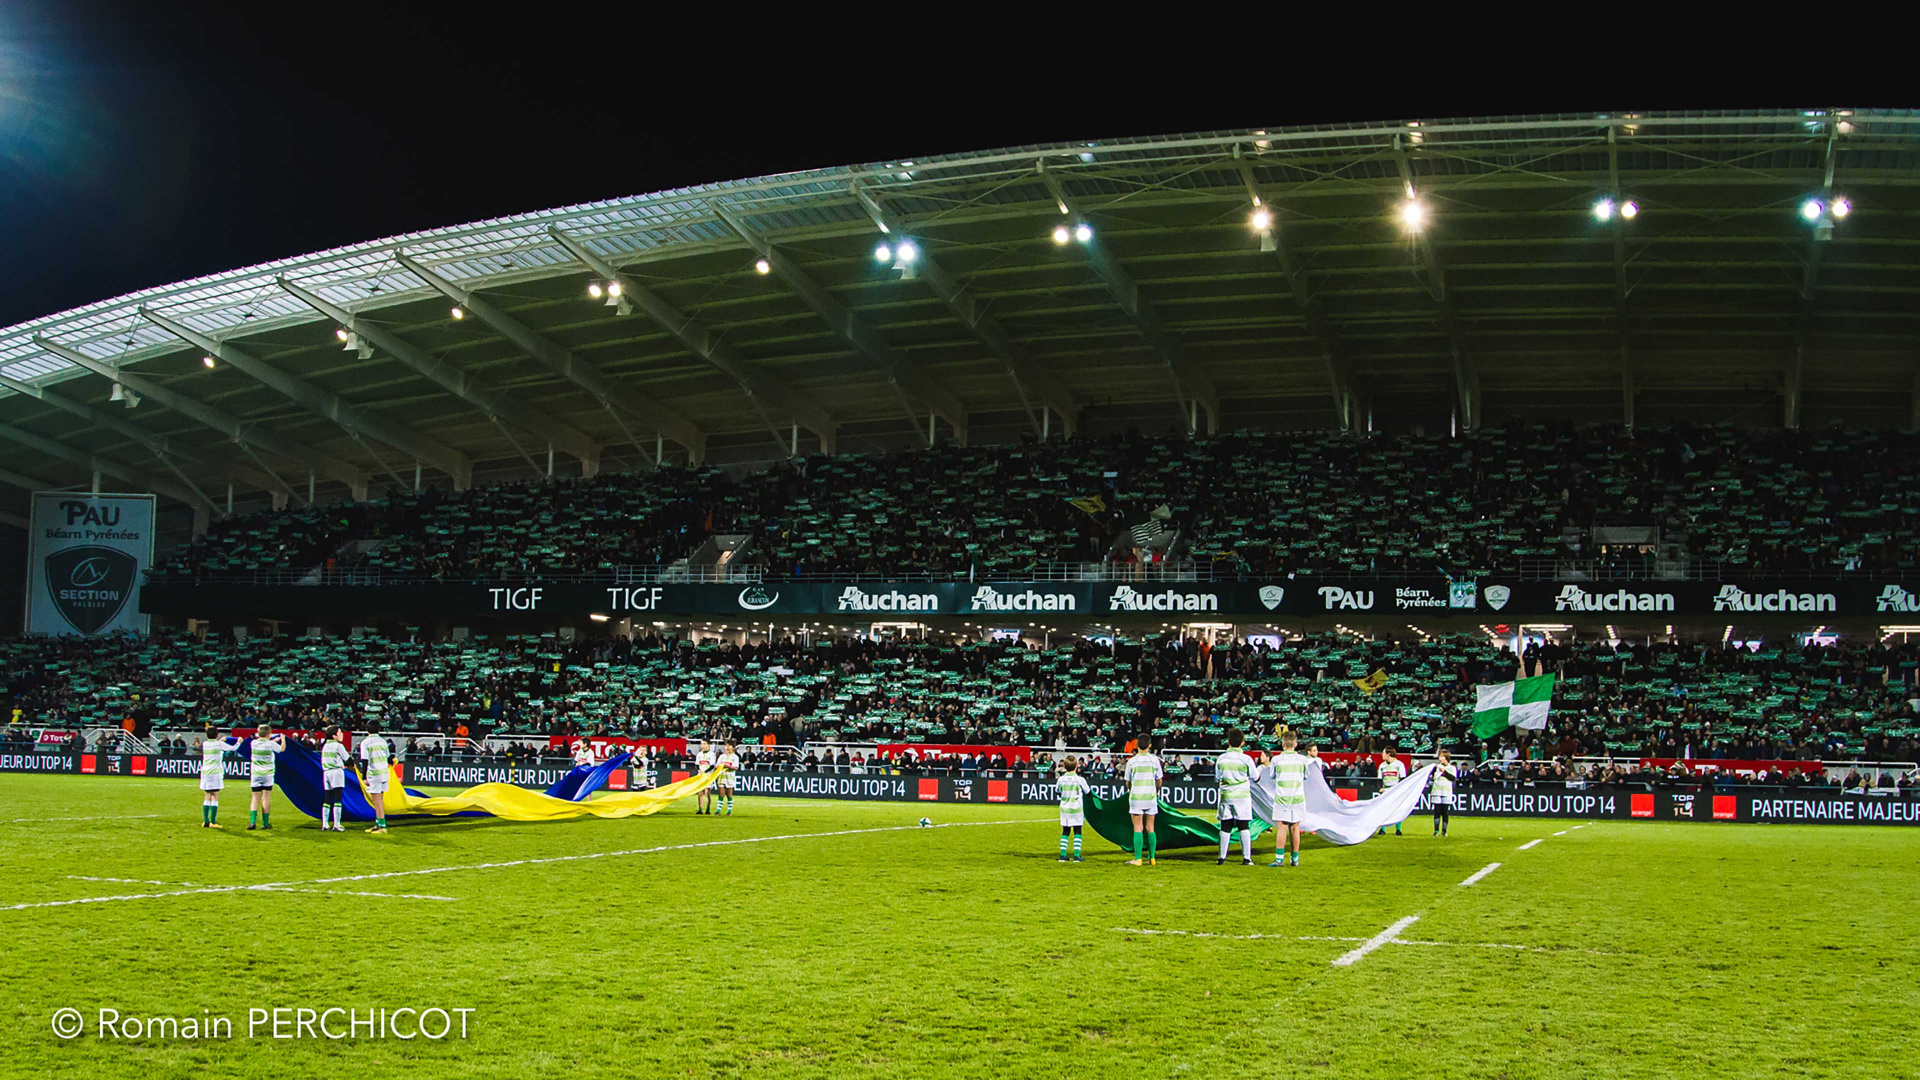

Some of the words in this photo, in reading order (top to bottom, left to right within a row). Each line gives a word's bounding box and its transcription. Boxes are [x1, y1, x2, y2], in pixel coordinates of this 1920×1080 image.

[60, 501, 120, 526] PAU
[46, 528, 82, 539] Béarn
[86, 529, 140, 541] Pyrénées
[60, 589, 119, 600] SECTION
[489, 588, 543, 610] TIGF
[607, 587, 663, 610] TIGF
[838, 586, 938, 611] Auchan
[971, 585, 1075, 611] Auchan
[1109, 585, 1218, 611] Auchan
[1317, 586, 1374, 610] PAU
[1396, 588, 1429, 597] Béarn
[1555, 584, 1675, 611] Auchan
[1713, 584, 1837, 612] Auchan
[1396, 598, 1446, 608] Pyrénées
[24, 756, 40, 770] DU
[41, 756, 61, 770] TOP
[62, 756, 73, 771] 14
[156, 759, 202, 774] PARTENA
[222, 761, 250, 775] MAJE
[414, 766, 485, 782] PARTENAIRE
[488, 768, 536, 785] MAJEUR
[538, 770, 555, 785] DU
[783, 777, 837, 795] MAJEUR
[840, 779, 860, 795] DU
[862, 779, 889, 796] TOP
[891, 780, 906, 797] 14
[954, 791, 972, 800] 14
[1174, 786, 1195, 804] DU
[1197, 787, 1218, 804] TO
[1470, 794, 1534, 812] MAJEUR
[1538, 795, 1561, 813] DU
[1564, 795, 1596, 814] TOP
[1598, 796, 1616, 814] 14
[1673, 808, 1694, 817] 14
[1752, 799, 1854, 820] PARTENAIRE
